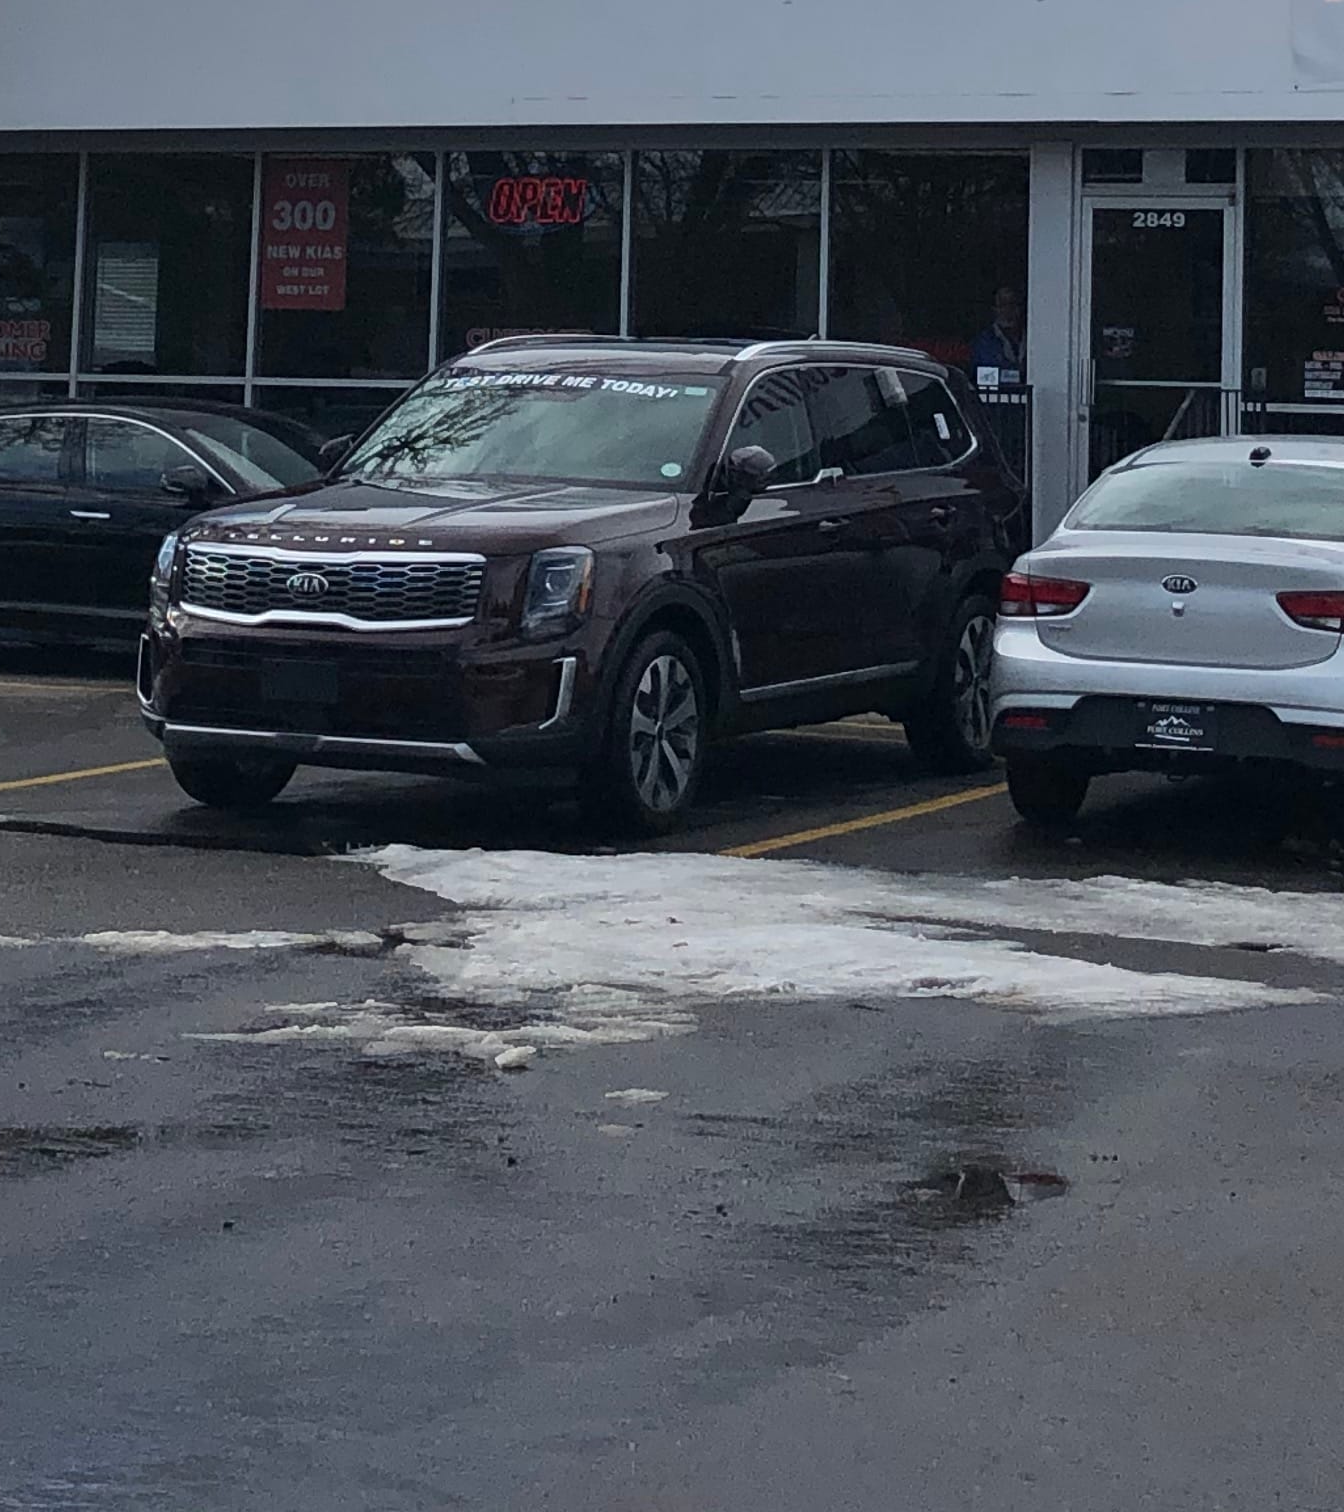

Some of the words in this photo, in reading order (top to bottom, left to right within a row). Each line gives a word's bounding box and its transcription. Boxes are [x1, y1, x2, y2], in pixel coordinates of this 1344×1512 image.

[286, 172, 330, 189] OVER
[488, 176, 587, 224] OPEN
[272, 200, 336, 231] 300
[1132, 212, 1186, 228] 2849
[267, 245, 301, 260] NEW
[306, 245, 343, 260] KIAS
[443, 375, 496, 389] TEST
[495, 374, 562, 386] DRIVE
[562, 375, 597, 388] ME
[228, 532, 433, 546] TELLURIDE
[292, 575, 321, 594] KIA
[1166, 577, 1192, 591] KIA
